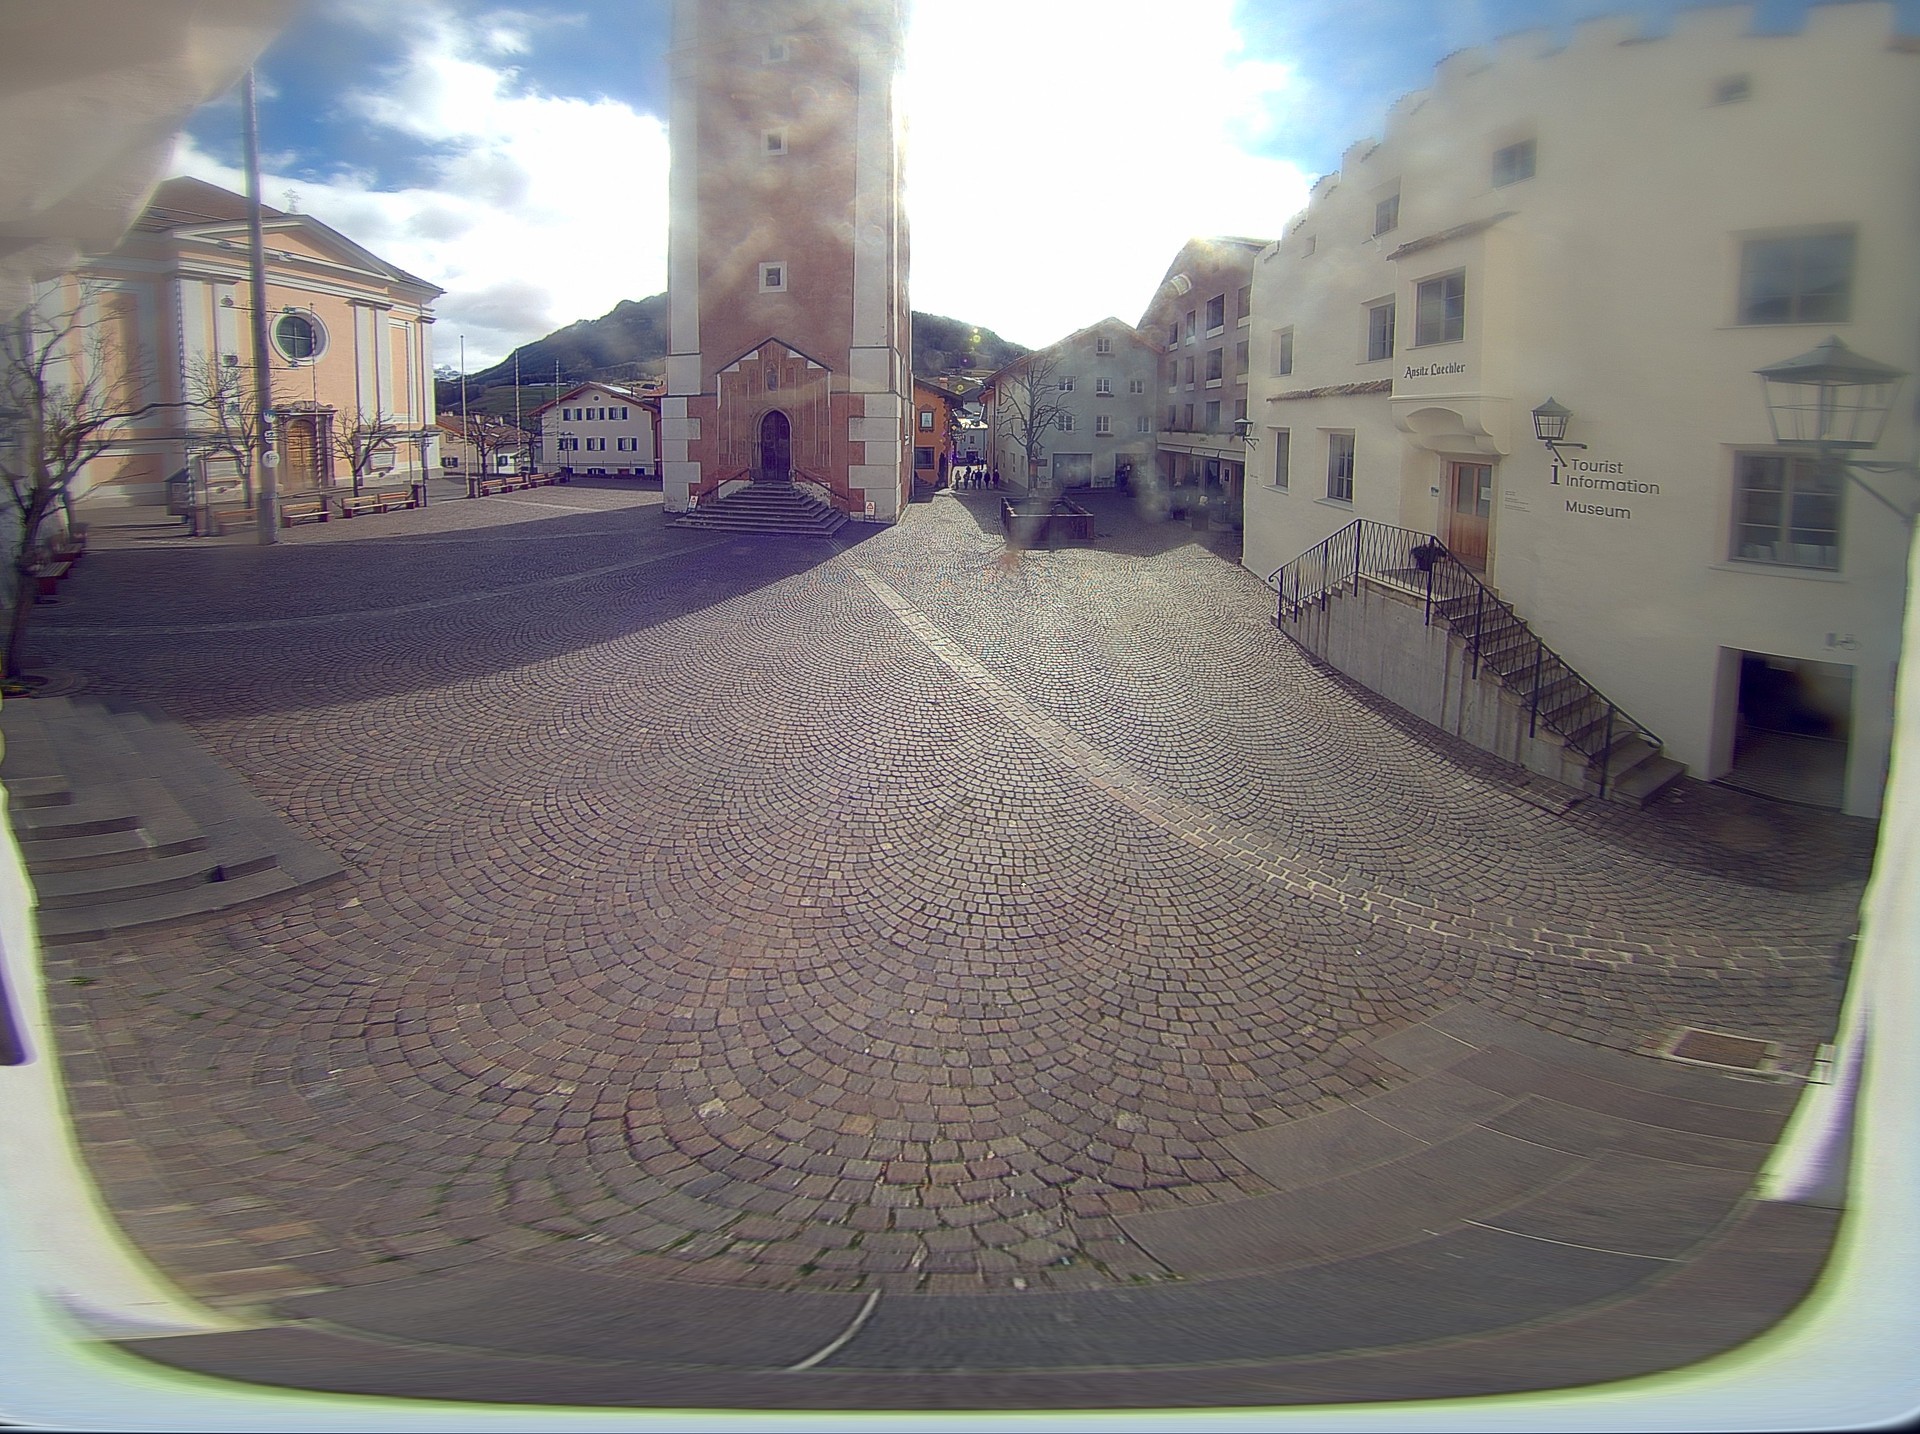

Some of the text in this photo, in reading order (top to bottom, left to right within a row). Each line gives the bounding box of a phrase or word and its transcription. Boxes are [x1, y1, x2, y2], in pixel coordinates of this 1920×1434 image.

[1404, 366, 1429, 379] Ansitz
[1571, 459, 1624, 474] Tourist
[1566, 475, 1660, 495] Information
[1566, 500, 1631, 519] Museum
